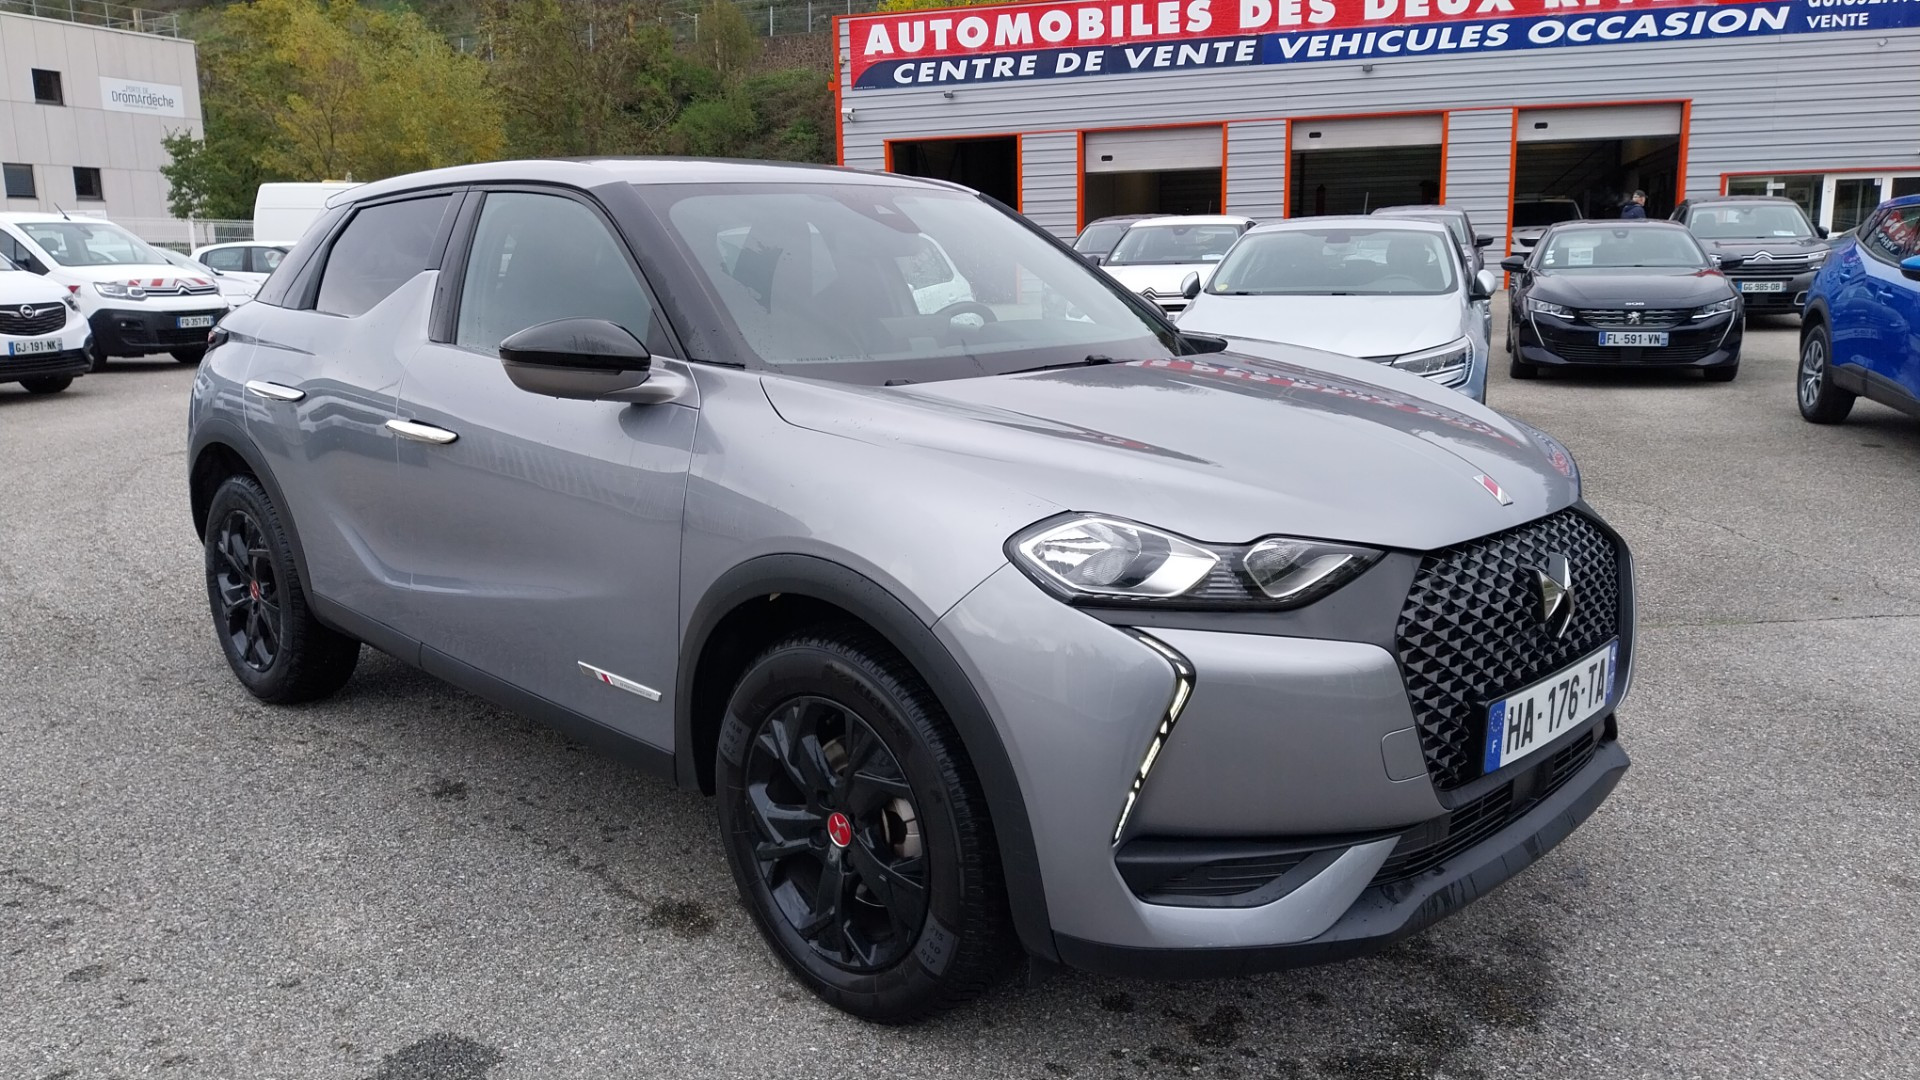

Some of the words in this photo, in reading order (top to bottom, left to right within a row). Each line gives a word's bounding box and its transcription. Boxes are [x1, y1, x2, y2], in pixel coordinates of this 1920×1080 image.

[864, 0, 1212, 55] AUTOMOBILES
[1240, 0, 1336, 28] DES
[1807, 13, 1869, 29] VENTE
[894, 55, 1037, 84] CENTRE
[1055, 51, 1104, 73] DE
[1125, 40, 1257, 69] VENTE
[1279, 23, 1510, 58] VEHICULES
[1528, 6, 1790, 44] OCCASION
[15, 340, 57, 353] GJ-191-NK
[1606, 333, 1660, 344] FL-591-VN
[1506, 658, 1605, 755] HA-176-TA
[1491, 739, 1498, 754] F
